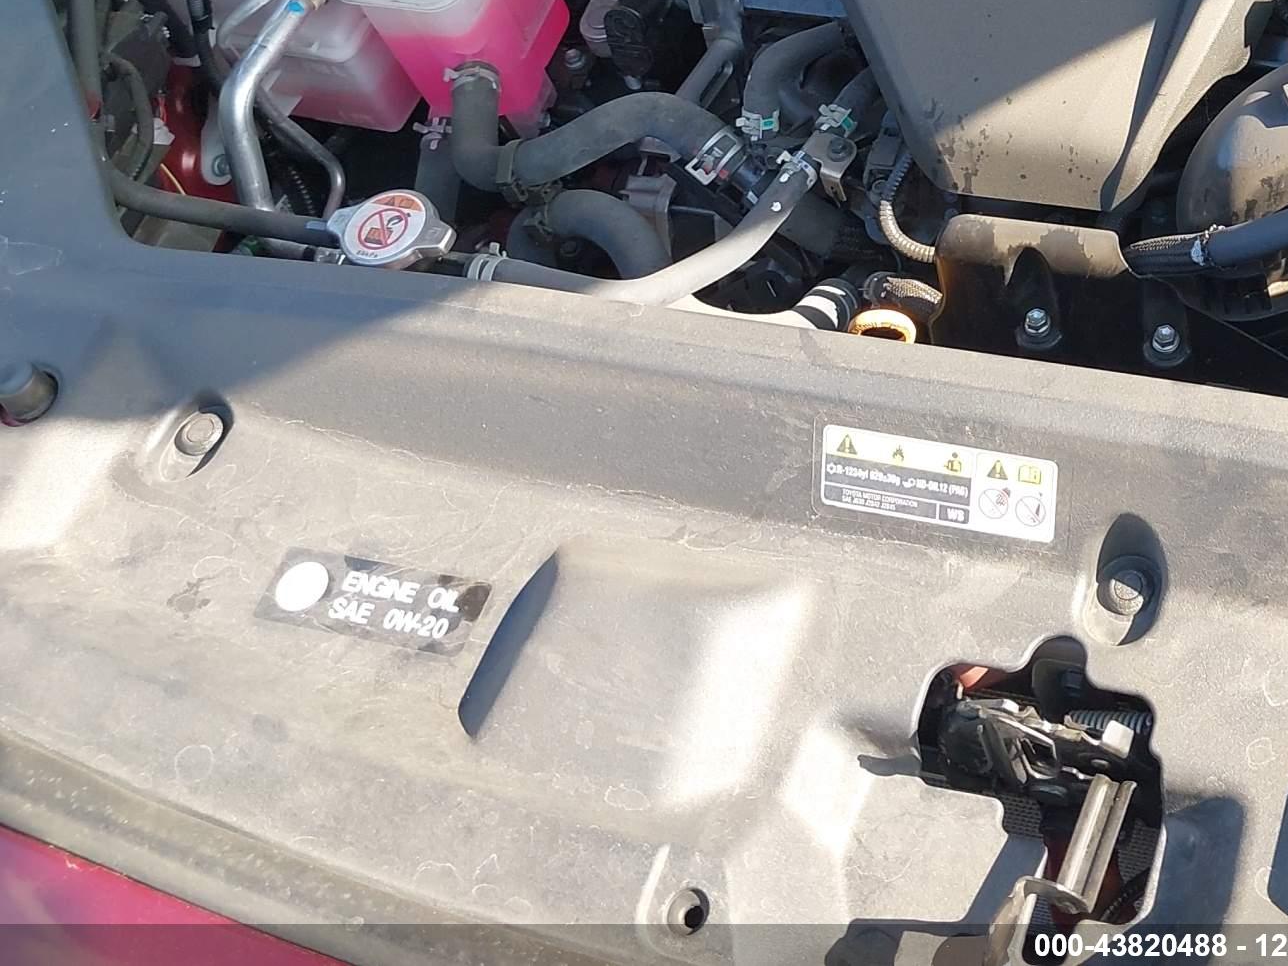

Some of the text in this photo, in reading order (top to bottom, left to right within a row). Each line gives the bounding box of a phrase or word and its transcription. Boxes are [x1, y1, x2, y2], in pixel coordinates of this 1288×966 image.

[341, 570, 460, 613] ENGINE OIL
[328, 596, 449, 639] SAE 0W-20
